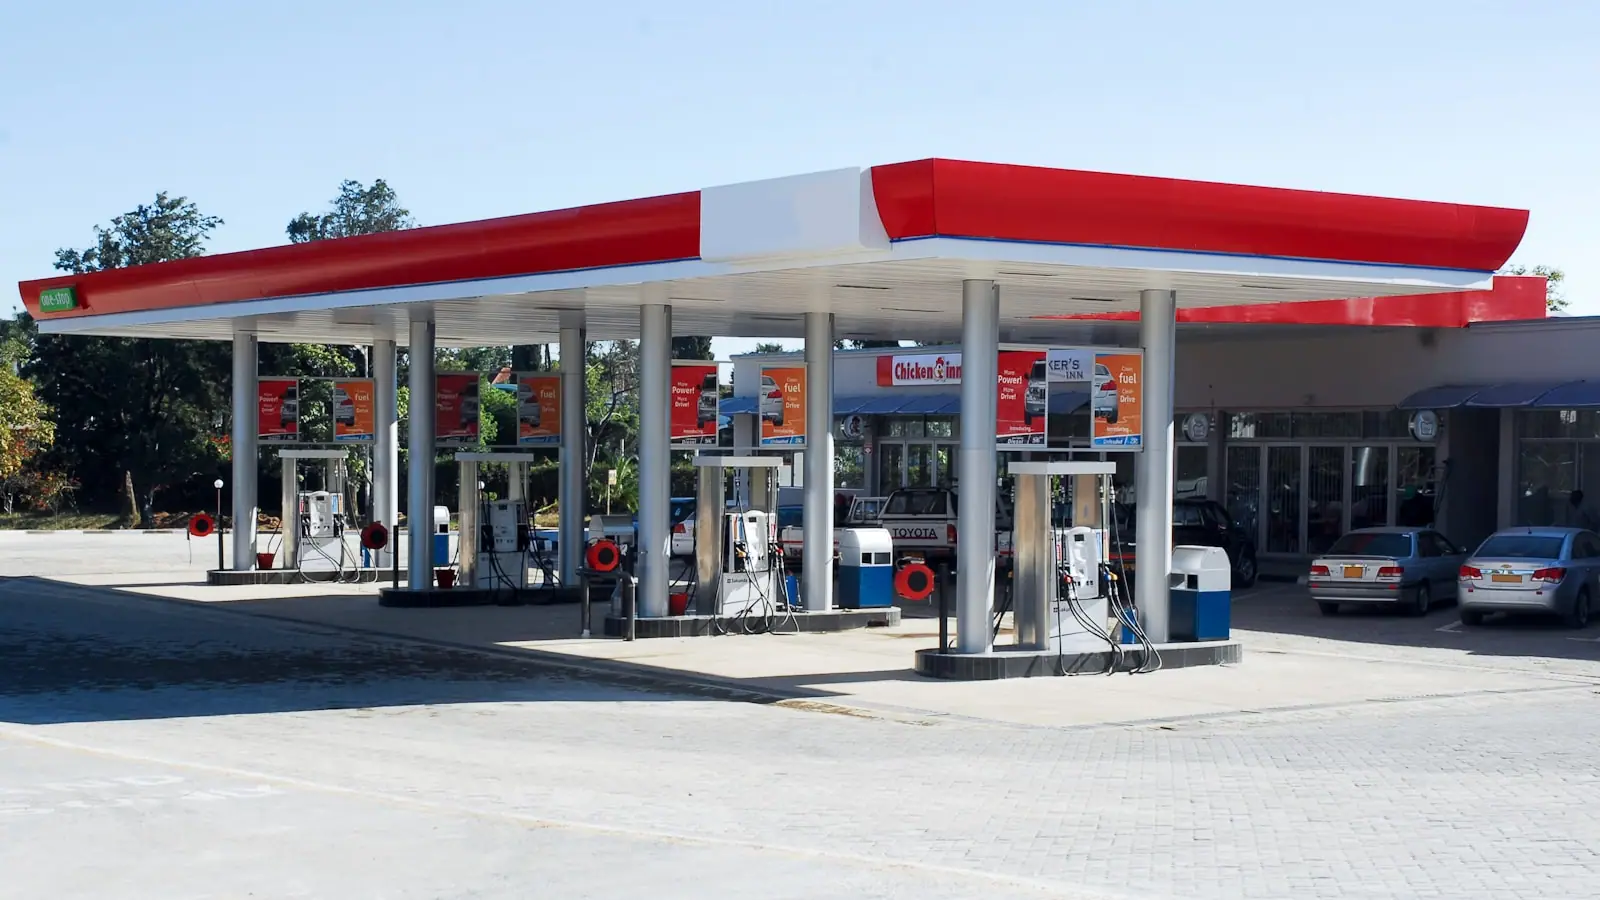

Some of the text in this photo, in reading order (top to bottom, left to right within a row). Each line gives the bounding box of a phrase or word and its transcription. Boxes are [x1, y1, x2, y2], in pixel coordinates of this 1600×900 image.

[41, 292, 70, 308] one-stop
[895, 362, 933, 380] Chicken
[1066, 371, 1084, 379] INN
[998, 374, 1023, 384] Power!
[1119, 372, 1137, 384] fuel
[672, 386, 695, 394] Power!
[784, 382, 801, 393] fuel
[355, 393, 369, 401] fuel
[540, 389, 556, 399] fuel
[1119, 395, 1136, 403] Drive
[785, 401, 800, 409] Drive
[892, 527, 938, 538] TOYOTA
